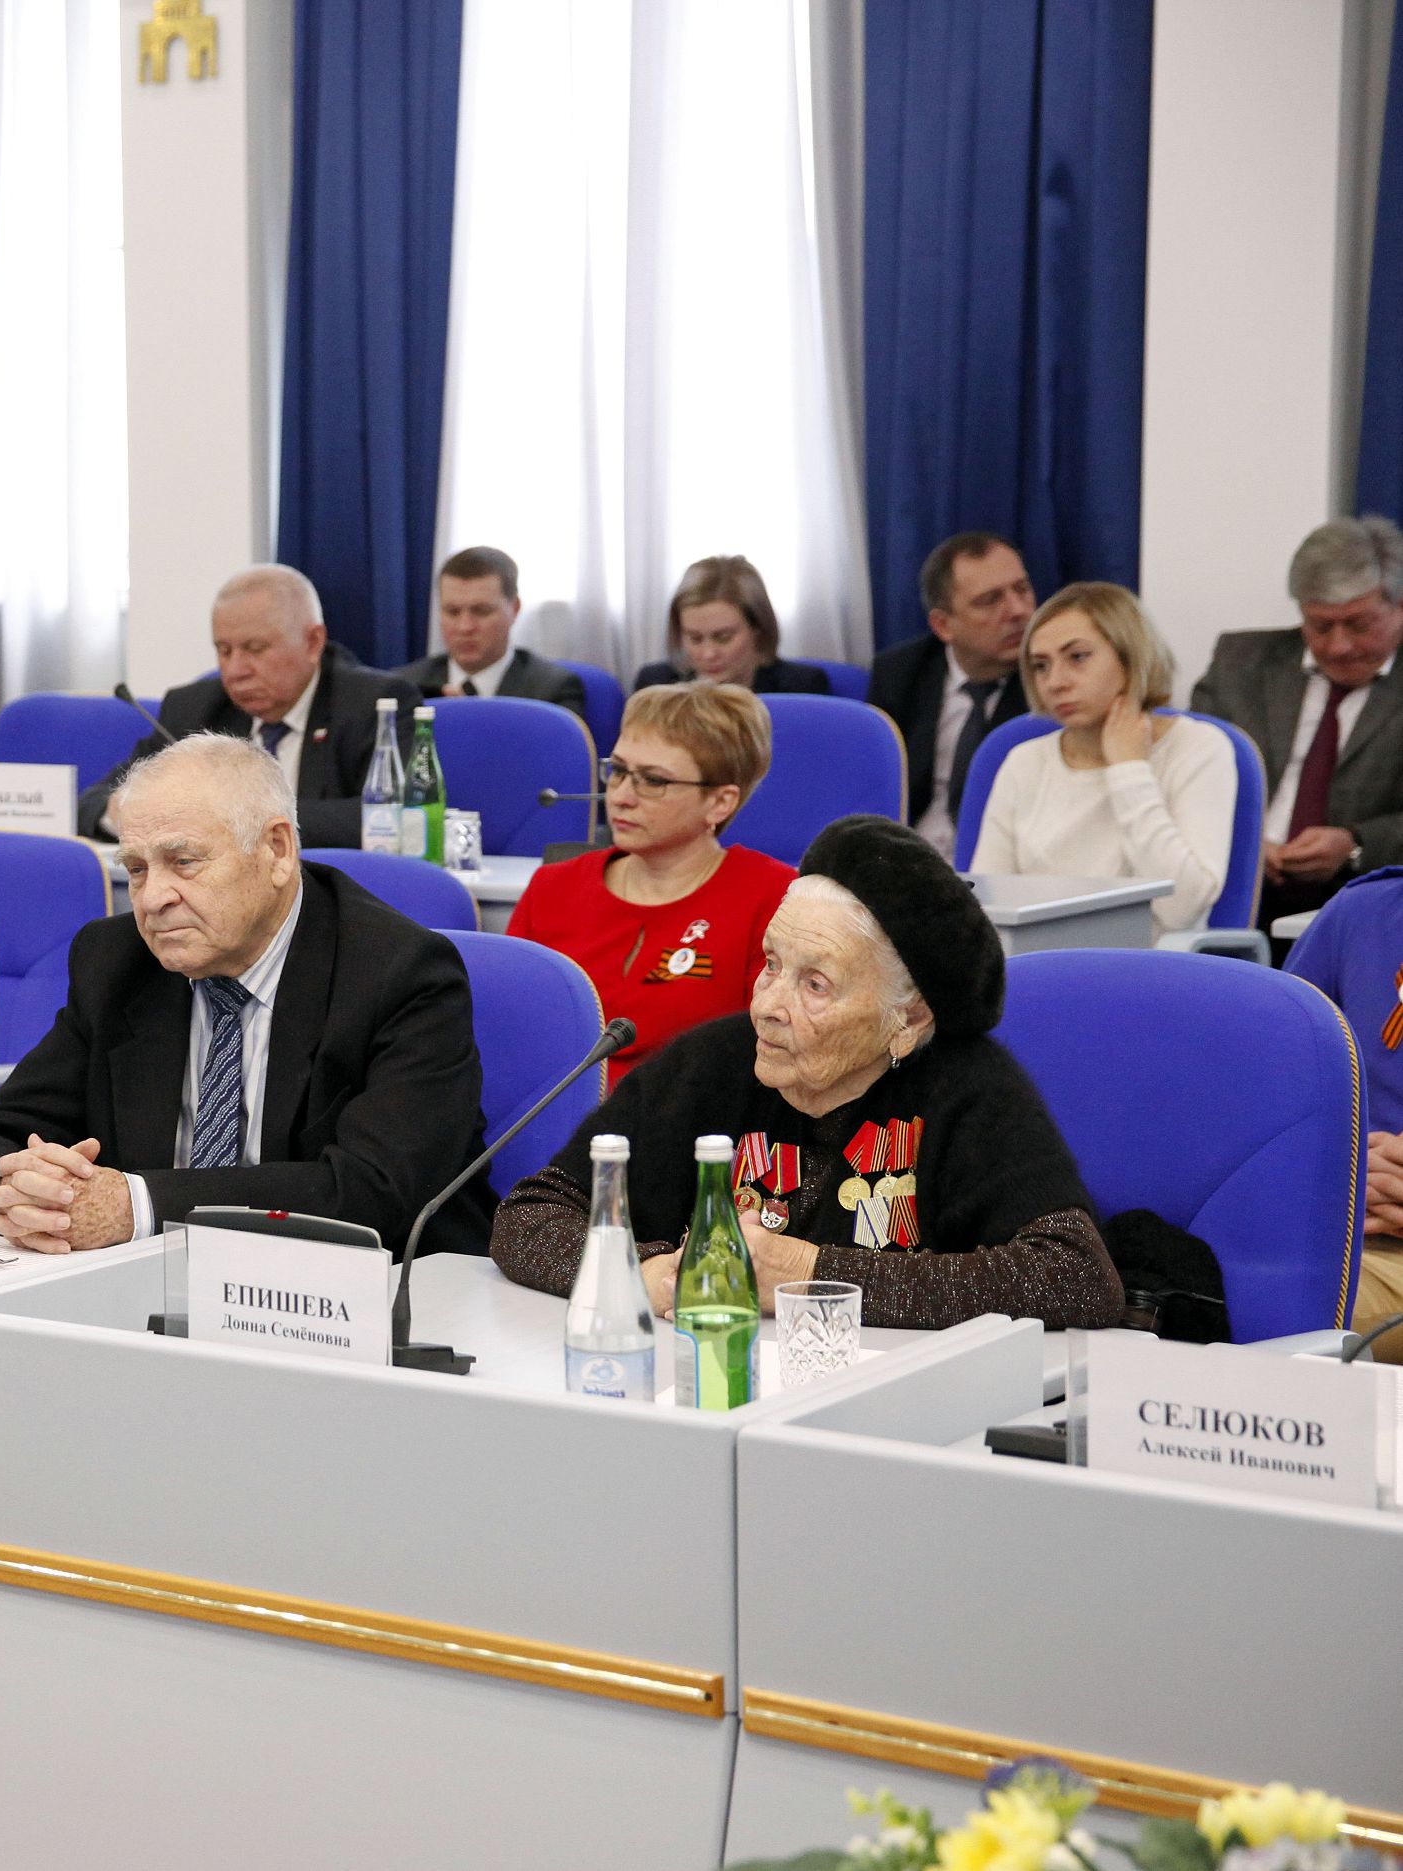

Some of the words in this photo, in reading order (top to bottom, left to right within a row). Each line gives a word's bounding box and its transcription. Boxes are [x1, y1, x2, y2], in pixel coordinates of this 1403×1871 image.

[223, 1282, 350, 1322] ЕПИШЕВА
[221, 1314, 267, 1334] Донна
[270, 1321, 351, 1348] Семёновна
[1138, 1401, 1326, 1447] СЕЛЮКОВ
[1138, 1438, 1222, 1463] Алексей
[1230, 1449, 1336, 1480] Иванович
